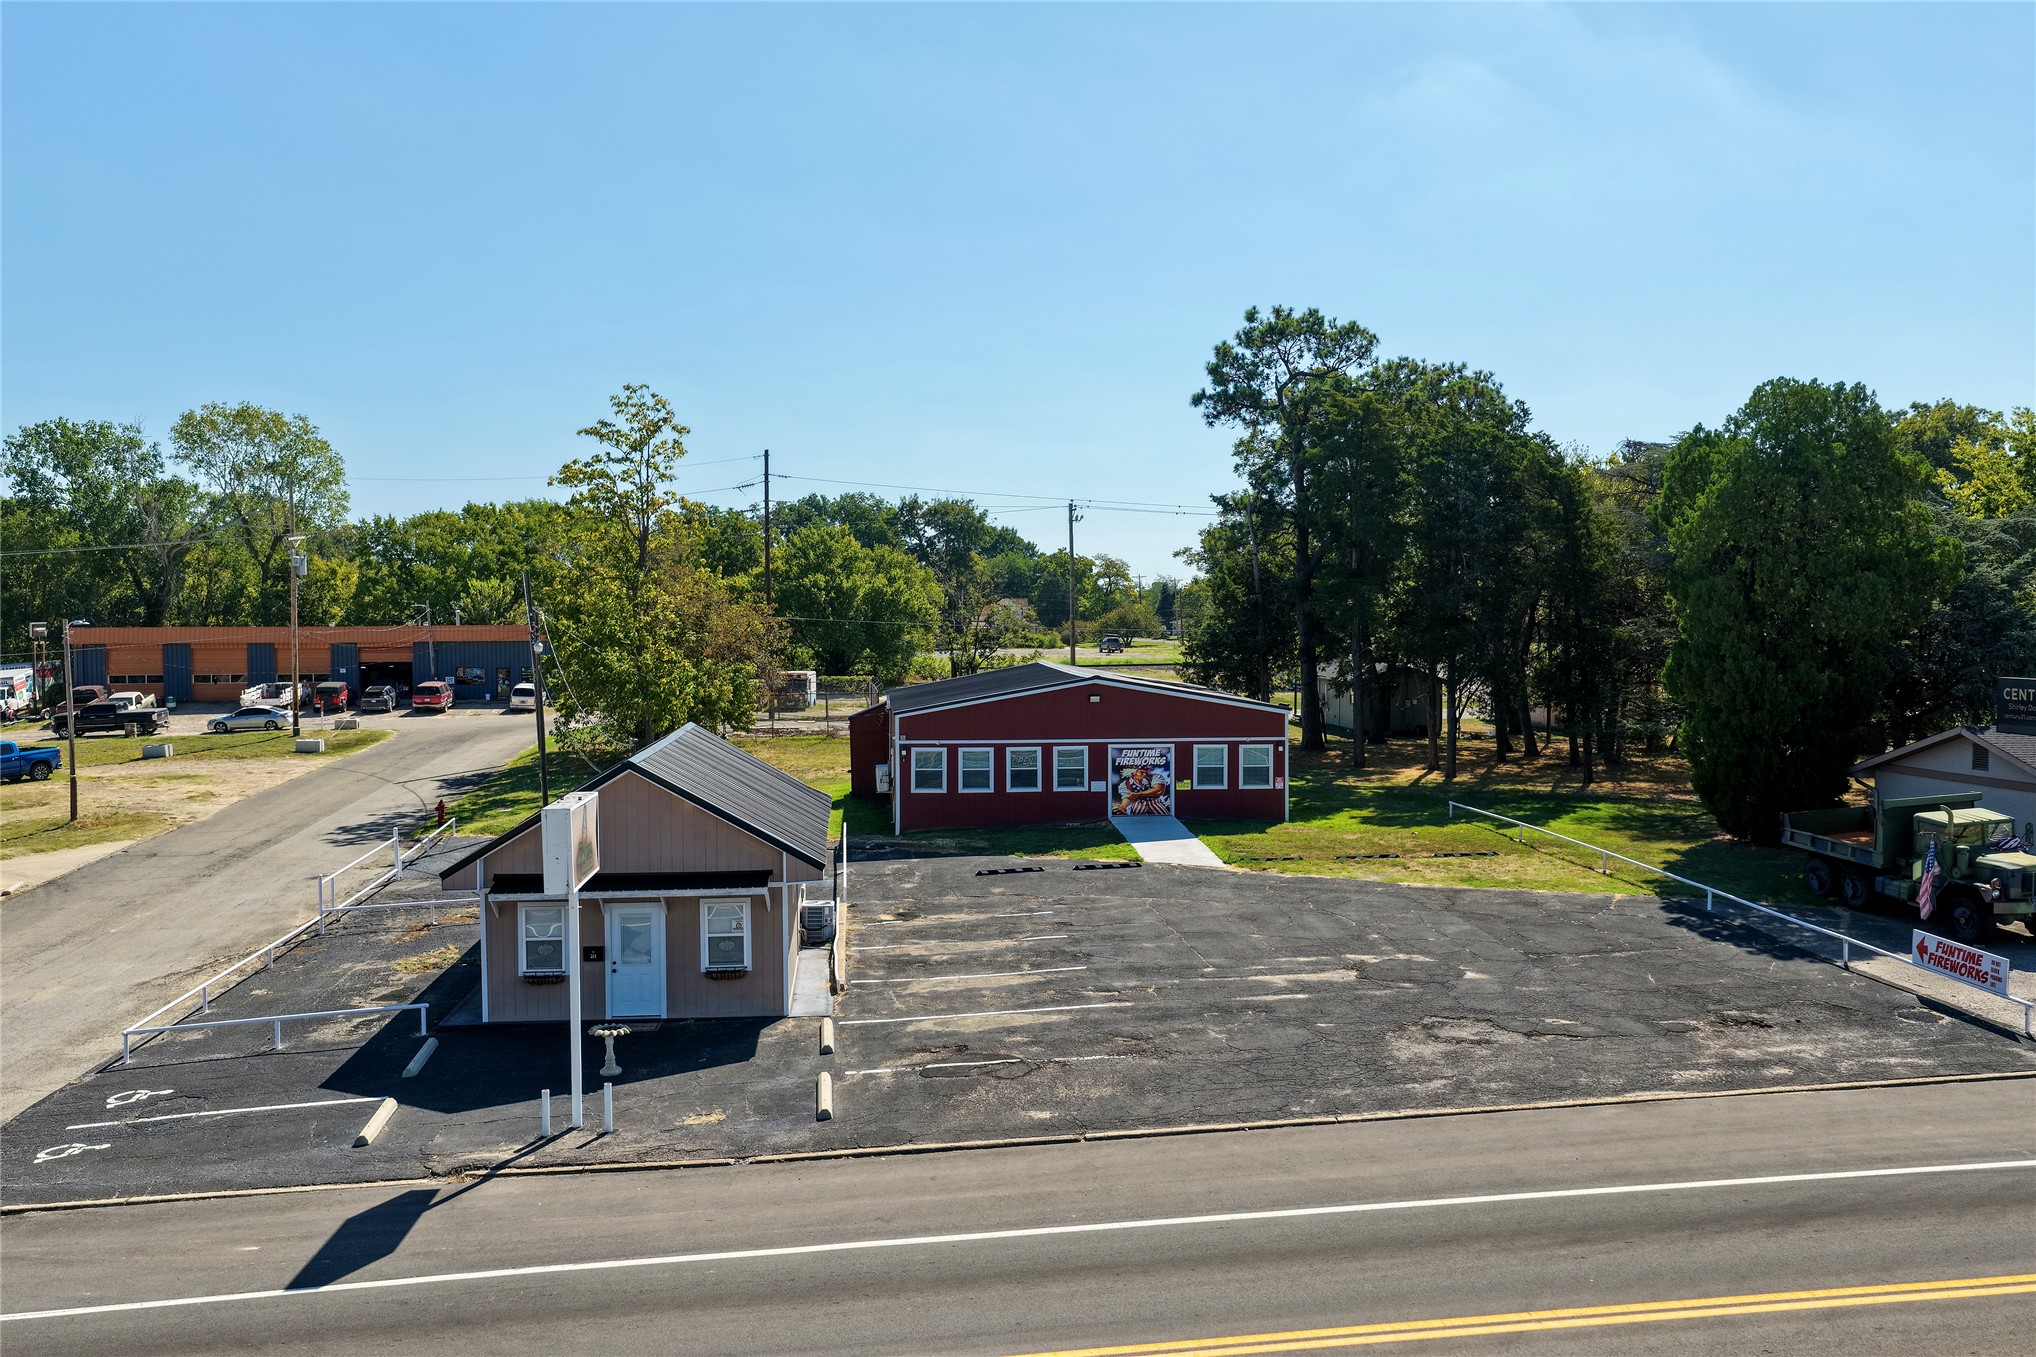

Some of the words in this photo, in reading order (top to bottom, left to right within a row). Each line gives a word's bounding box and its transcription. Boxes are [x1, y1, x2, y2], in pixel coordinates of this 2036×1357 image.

[2003, 688, 2035, 701] CENT
[2008, 702, 2028, 712] Shirley
[1121, 749, 1161, 758] FUNTIME
[1115, 757, 1166, 766] FIREWORKS
[1936, 941, 1983, 966] FUNTIME
[1928, 953, 1988, 983] FIREWORKS
